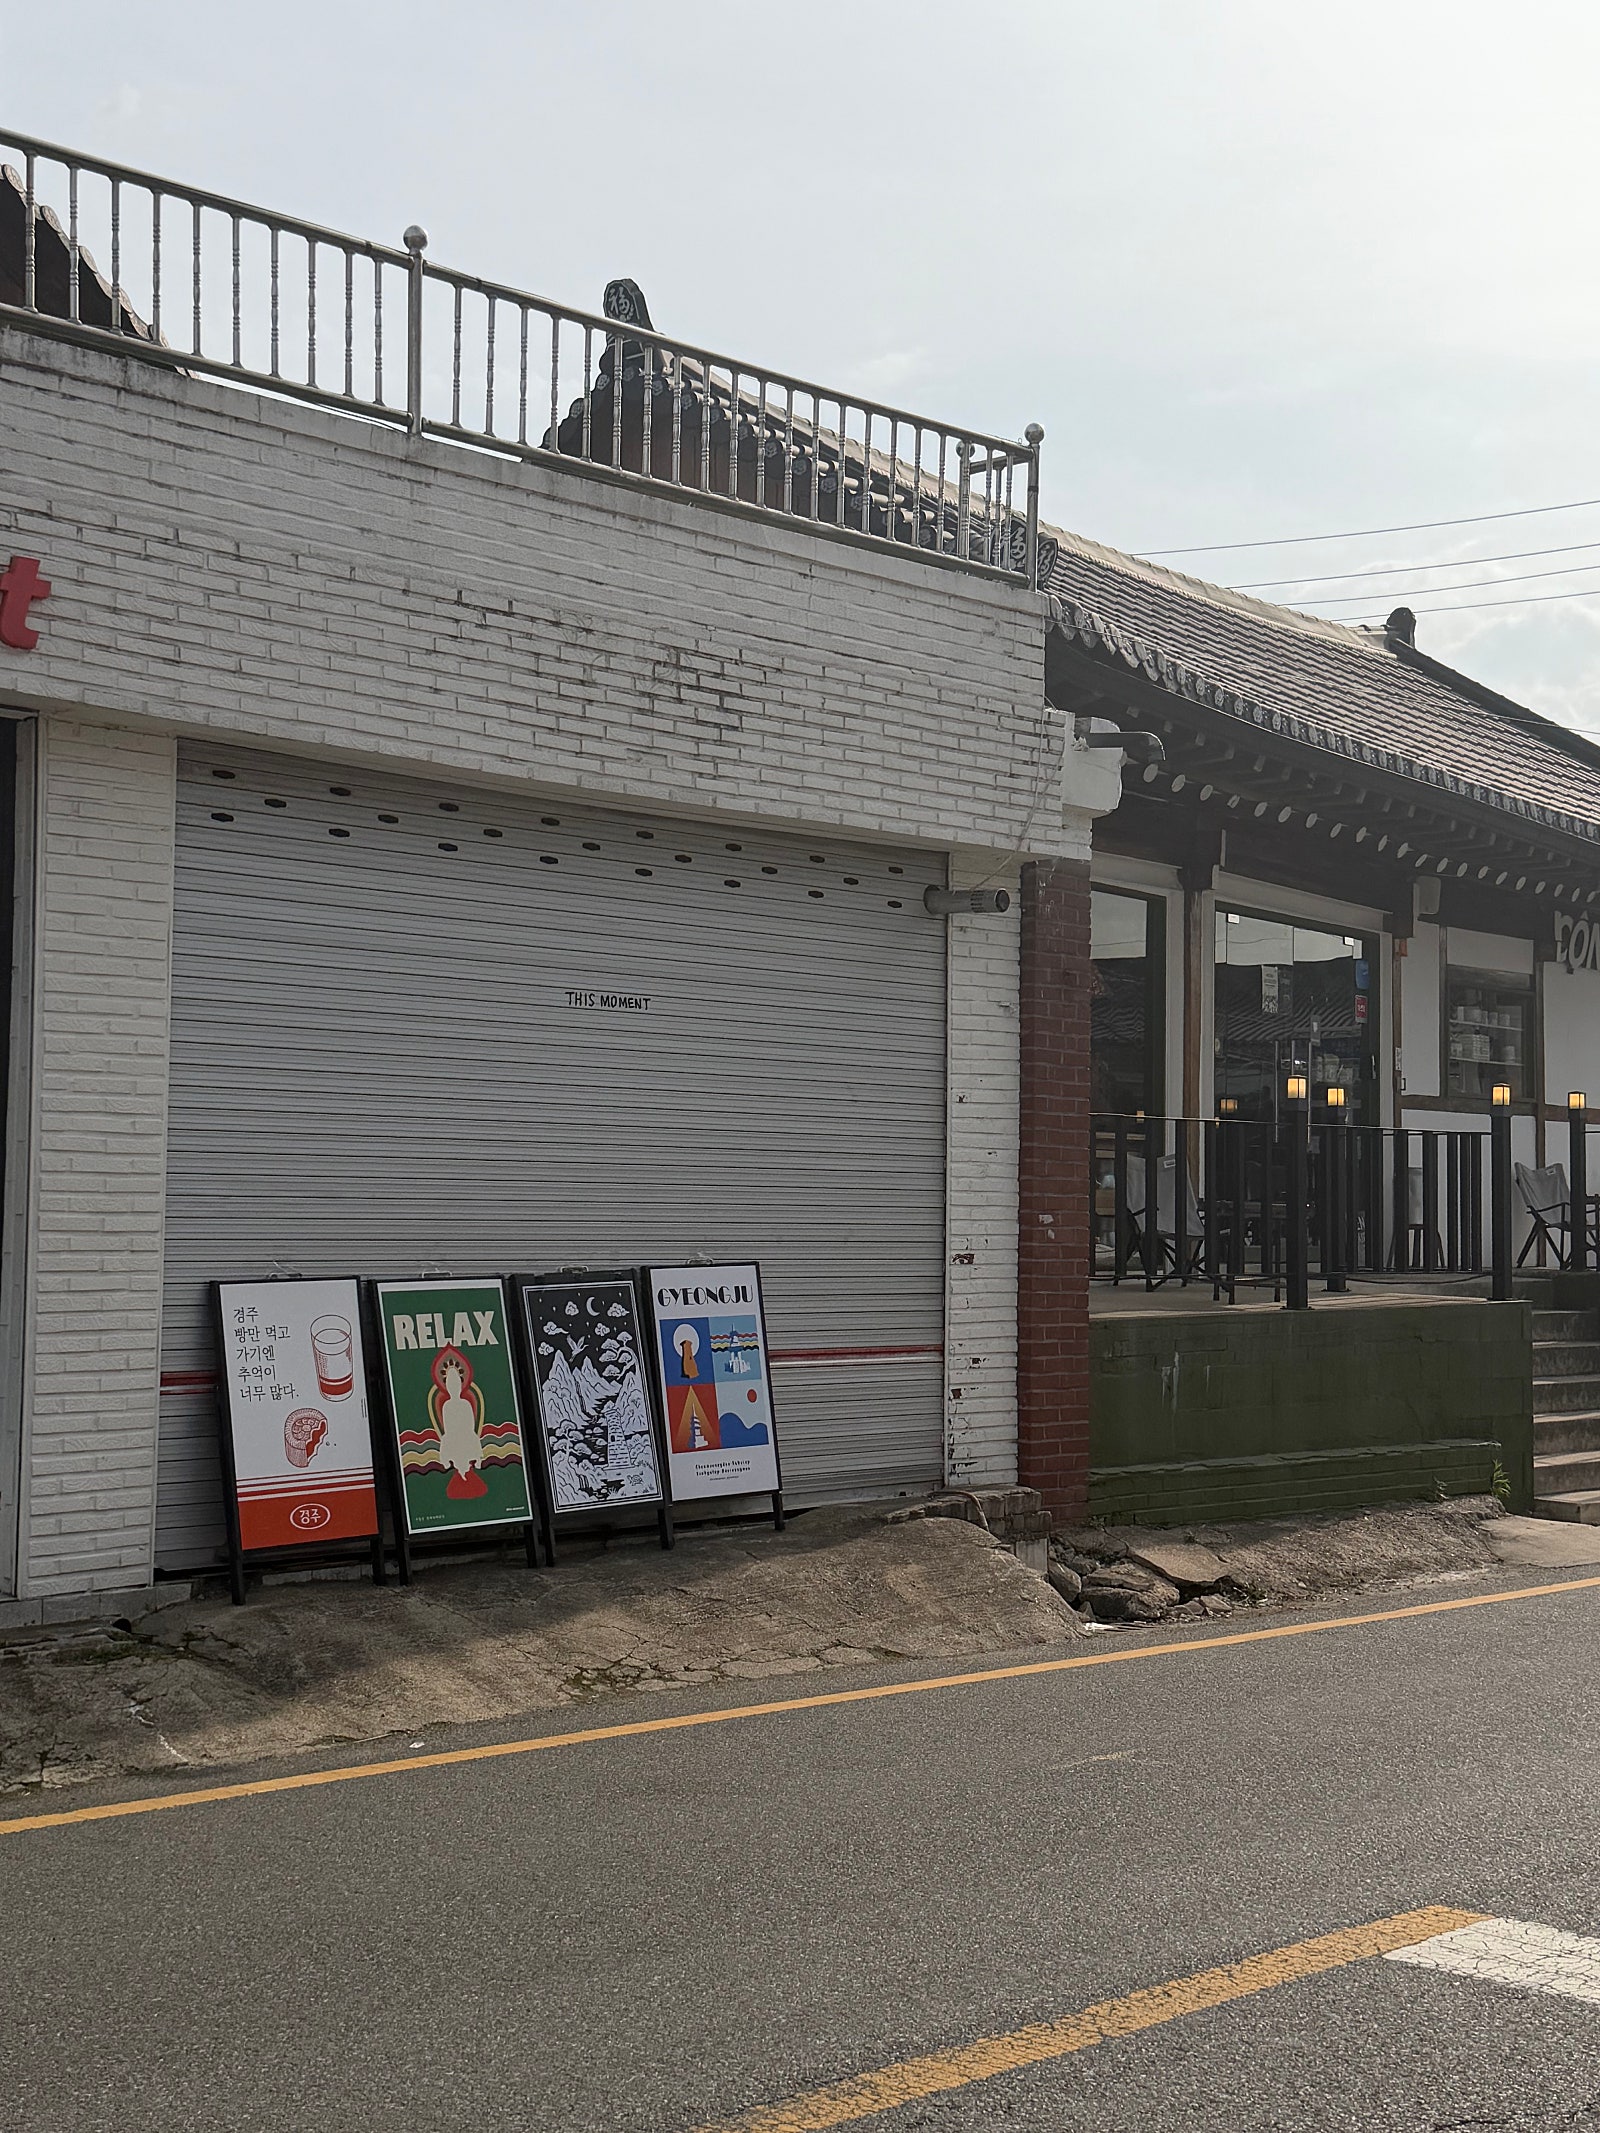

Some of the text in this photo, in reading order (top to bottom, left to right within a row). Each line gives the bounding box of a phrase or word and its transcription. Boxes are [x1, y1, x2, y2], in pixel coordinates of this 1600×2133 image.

[565, 991, 651, 1010] THIS MOMENT
[657, 1284, 754, 1307] GYEONGJU
[233, 1306, 259, 1323] 경주
[234, 1325, 291, 1343] 빵만 먹고
[392, 1310, 499, 1350] RELAX
[236, 1344, 276, 1362] 가기엔
[237, 1364, 276, 1382] 추억이
[240, 1383, 299, 1402] 너무 많다.
[299, 1508, 321, 1524] 경주
